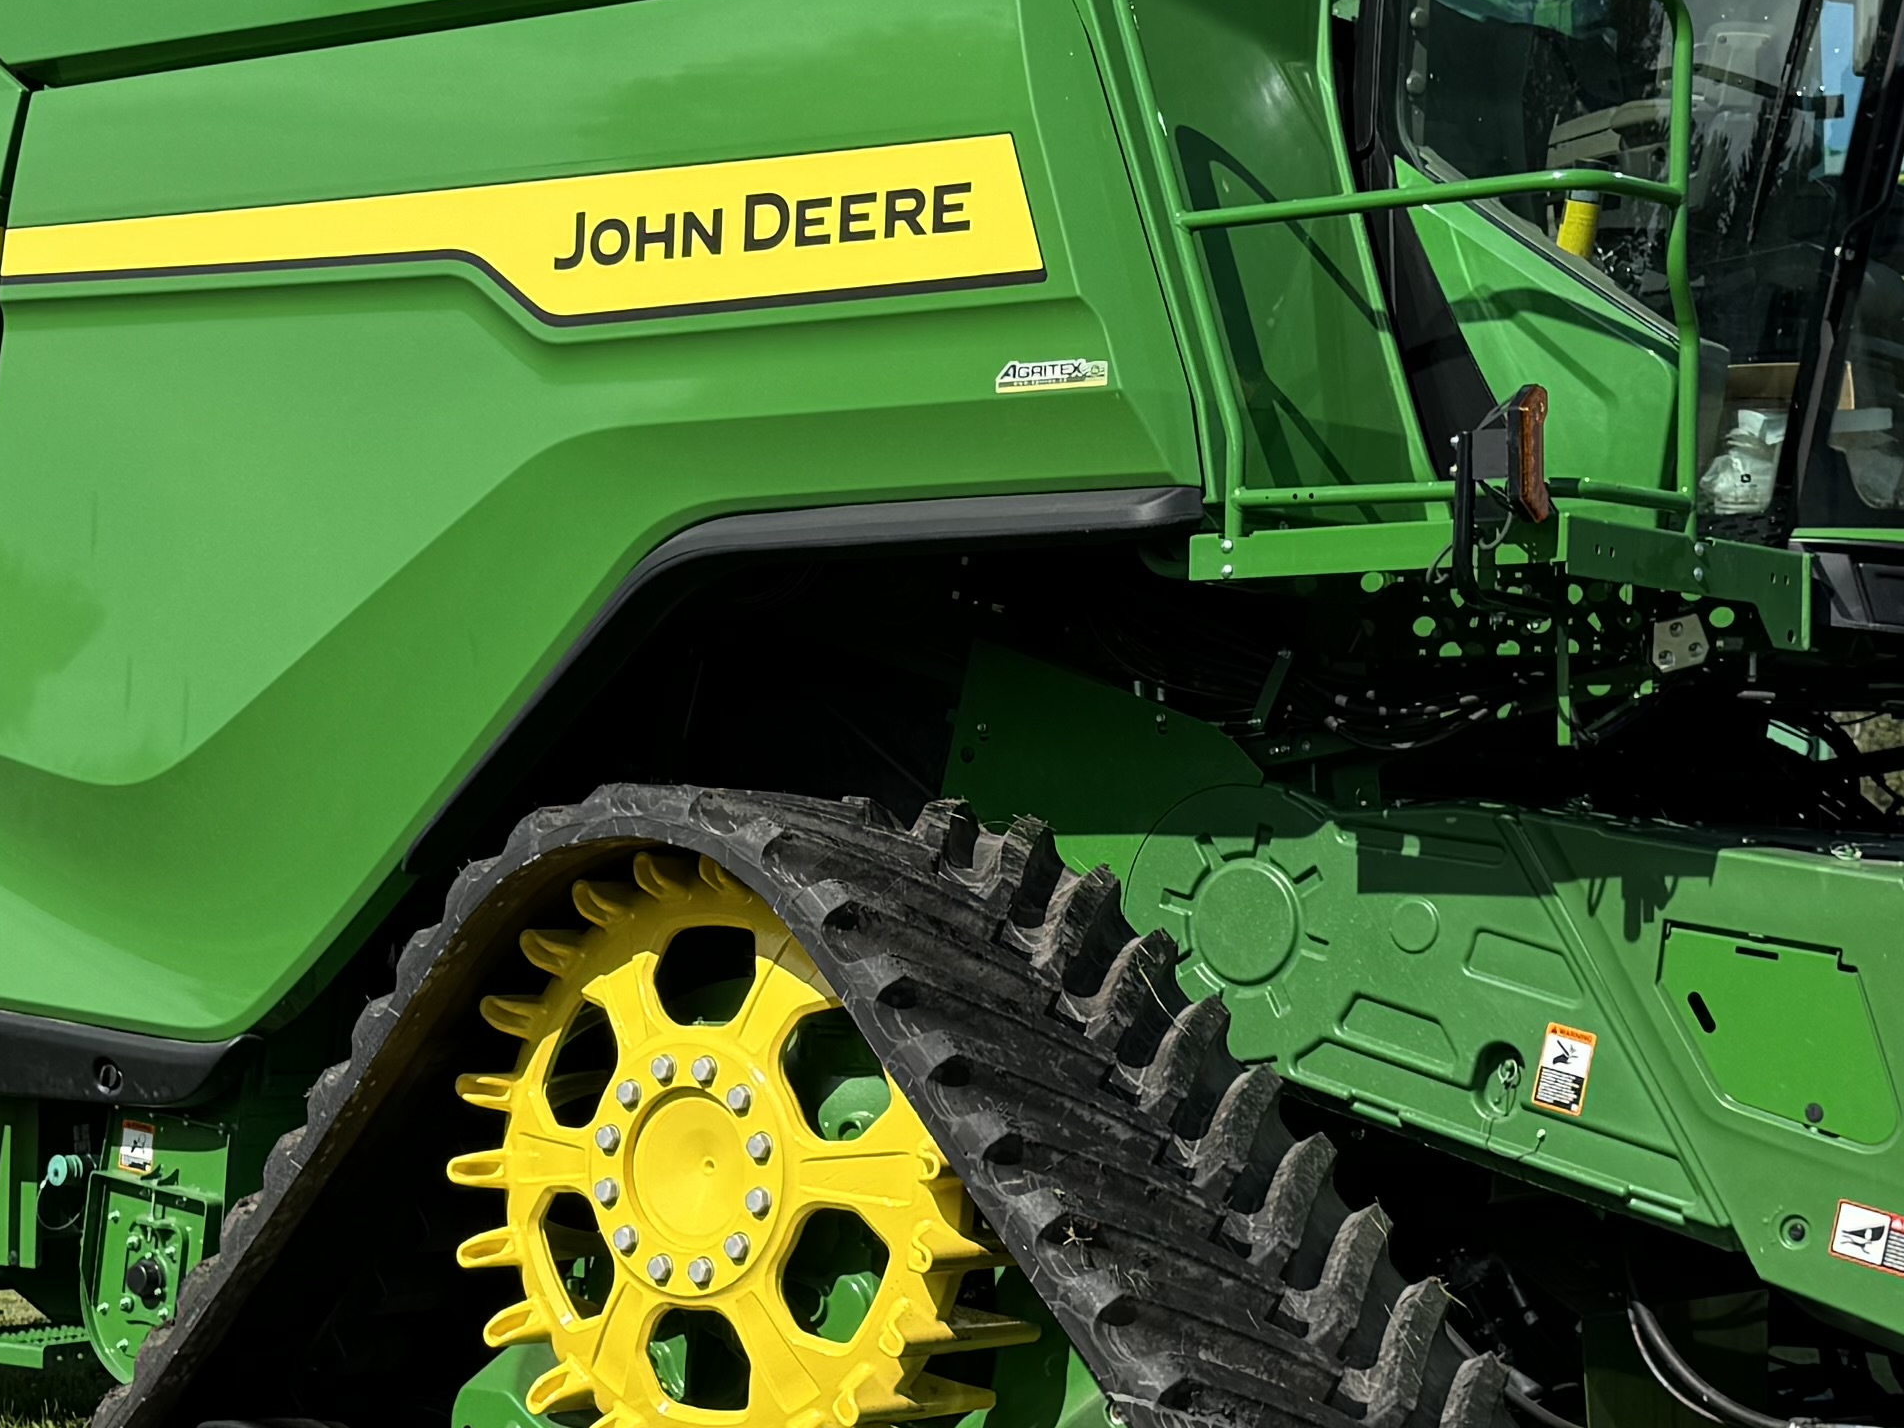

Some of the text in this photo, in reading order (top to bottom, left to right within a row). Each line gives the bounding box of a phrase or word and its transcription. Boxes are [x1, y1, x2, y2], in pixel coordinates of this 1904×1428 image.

[553, 182, 972, 270] JOHN DEERE
[1000, 362, 1083, 380] AGRITEX
